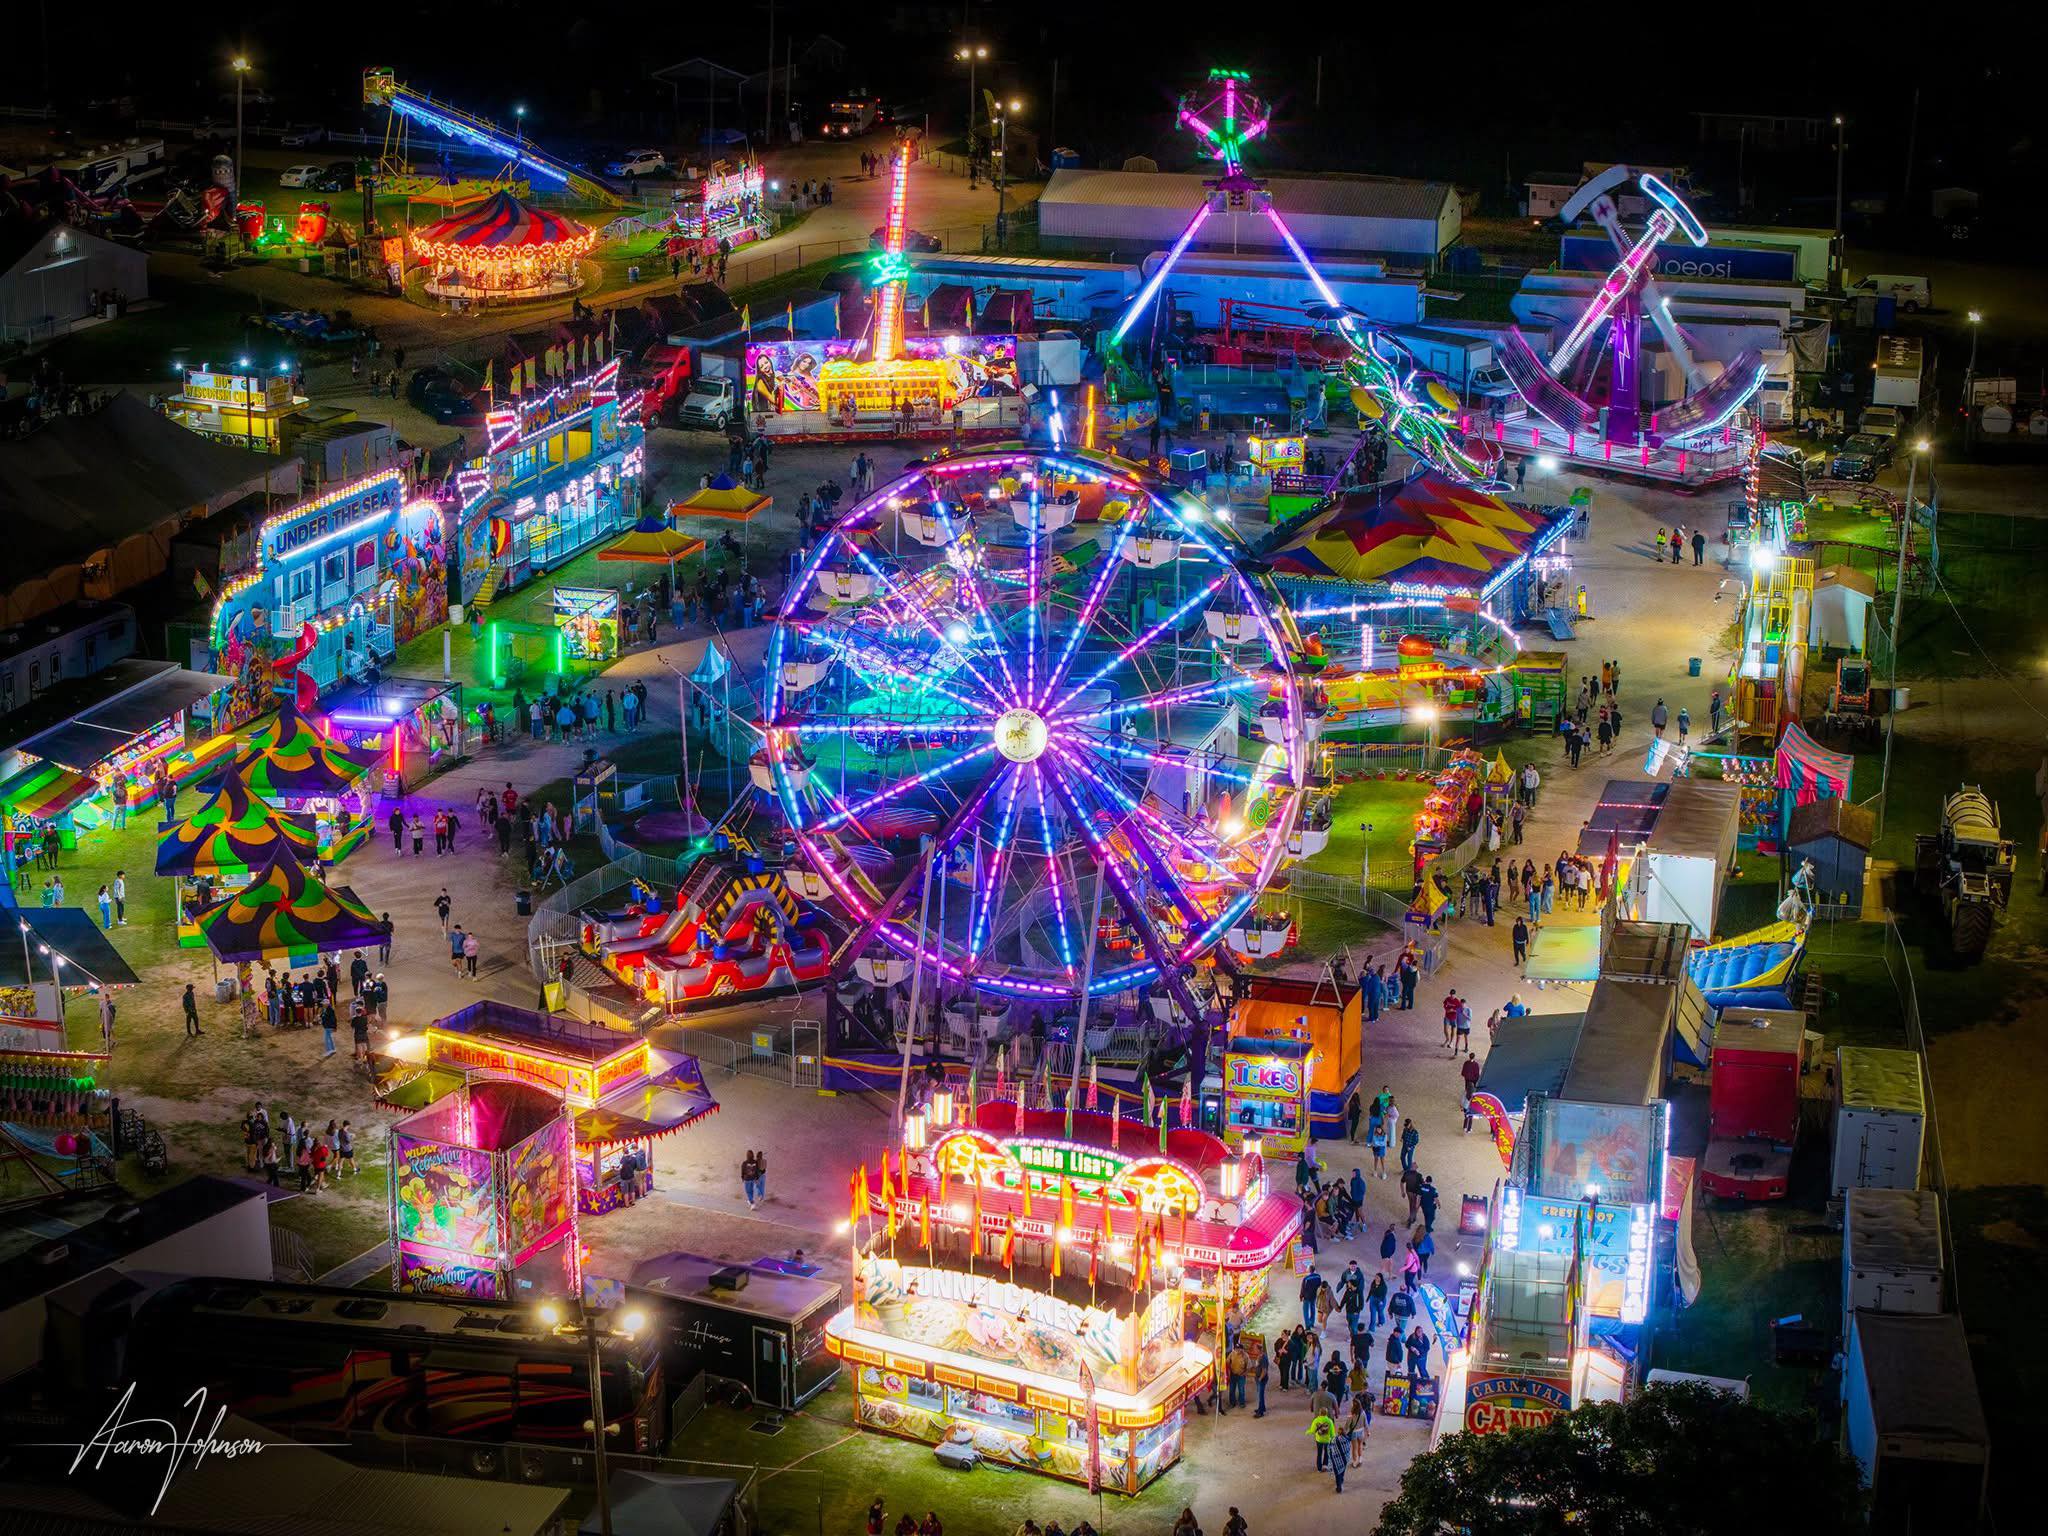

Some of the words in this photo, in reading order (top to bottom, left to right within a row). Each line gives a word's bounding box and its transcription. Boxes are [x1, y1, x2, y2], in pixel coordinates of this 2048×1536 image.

[1665, 260, 1731, 278] pepsi
[233, 391, 265, 405] CHESE
[276, 514, 328, 553] UNDER
[331, 500, 360, 532] THE
[361, 487, 392, 514] SEA
[1231, 1060, 1298, 1092] TICKETS
[404, 1145, 438, 1159] WILDLY
[1004, 1172, 1130, 1205] PIZZA
[896, 1201, 916, 1214] PIZZA
[1022, 1221, 1046, 1234] PIZZA
[1193, 1250, 1217, 1262] PIZZA
[902, 1266, 1001, 1310] FUNNEL
[1002, 1283, 1090, 1338] CAKES
[1472, 1380, 1563, 1406] CARNIVAL
[1466, 1401, 1560, 1437] CAND
